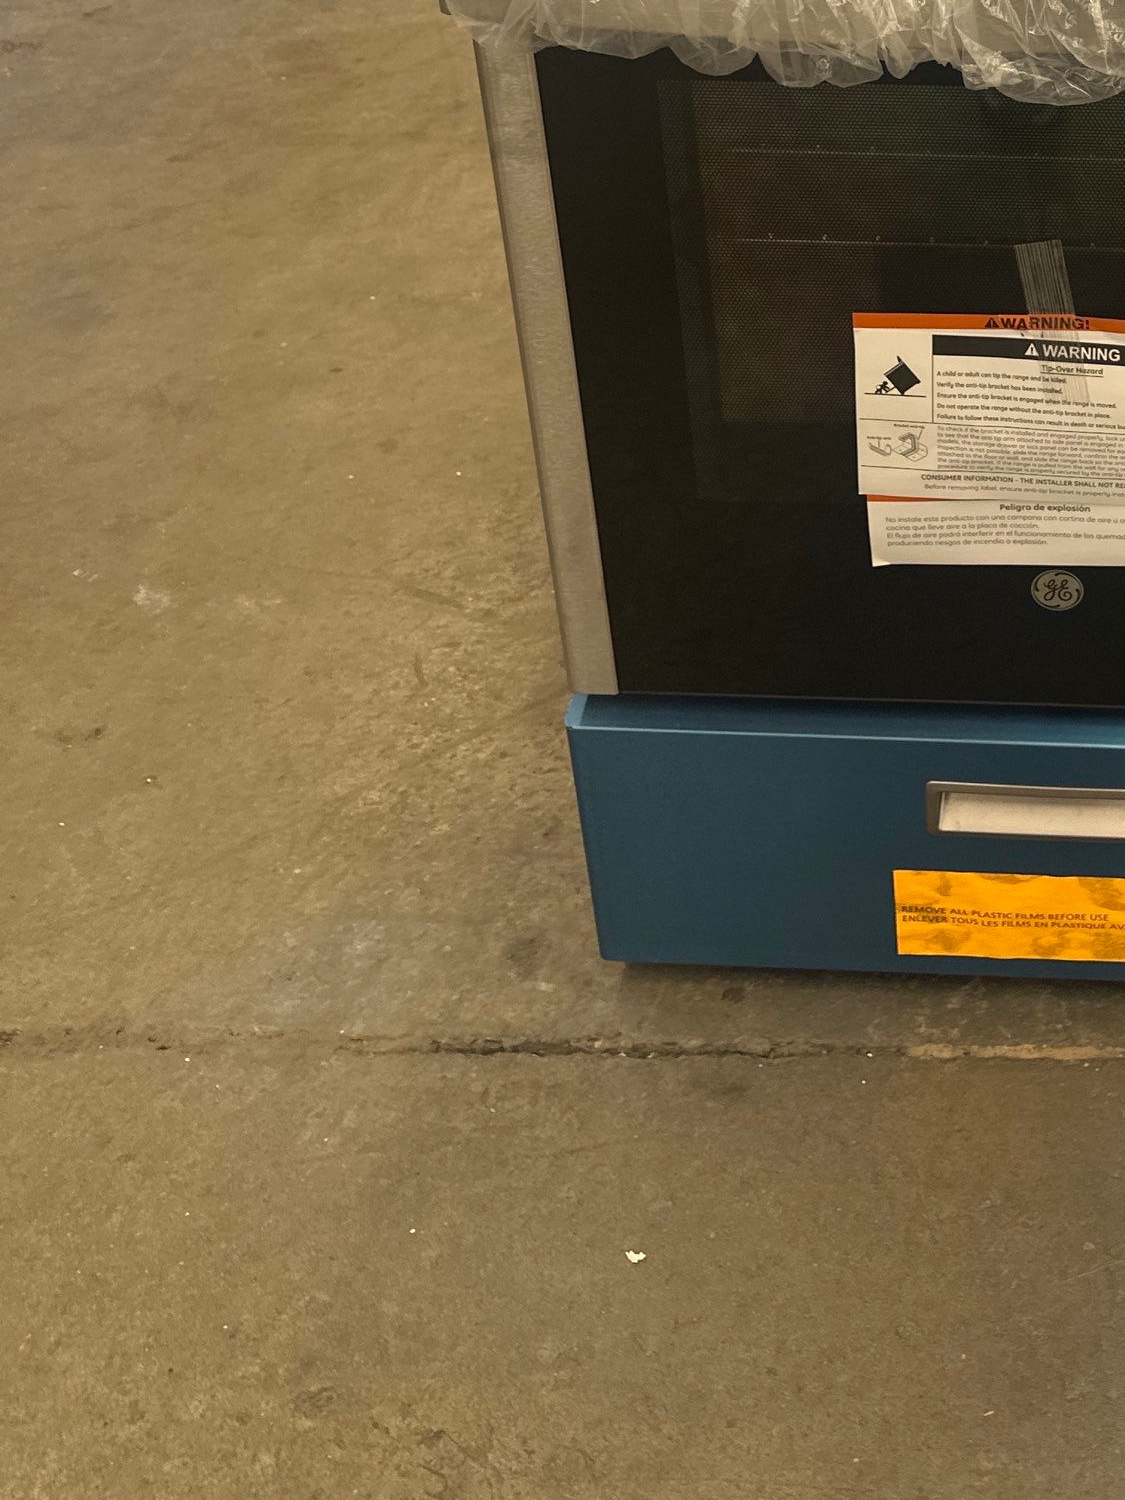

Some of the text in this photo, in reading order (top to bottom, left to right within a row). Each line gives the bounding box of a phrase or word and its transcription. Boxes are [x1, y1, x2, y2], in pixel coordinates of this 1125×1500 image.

[1000, 317, 1090, 331] WARNING!
[1042, 344, 1120, 362] WARNING
[1041, 364, 1103, 375] Tip-Over Hazard
[964, 474, 1013, 483] INFORMATION
[1035, 478, 1072, 486] INSTALLER
[1047, 504, 1091, 513] explosión
[941, 515, 974, 523] producto
[1006, 514, 1042, 522] campana
[1059, 515, 1085, 523] cortina
[901, 906, 946, 914] REMOVE
[950, 908, 968, 916] ALL
[971, 910, 1011, 919] PLASTIC
[1048, 913, 1086, 921] BEFORE
[902, 914, 948, 923] ENLEVER
[951, 917, 978, 925] TOUS
